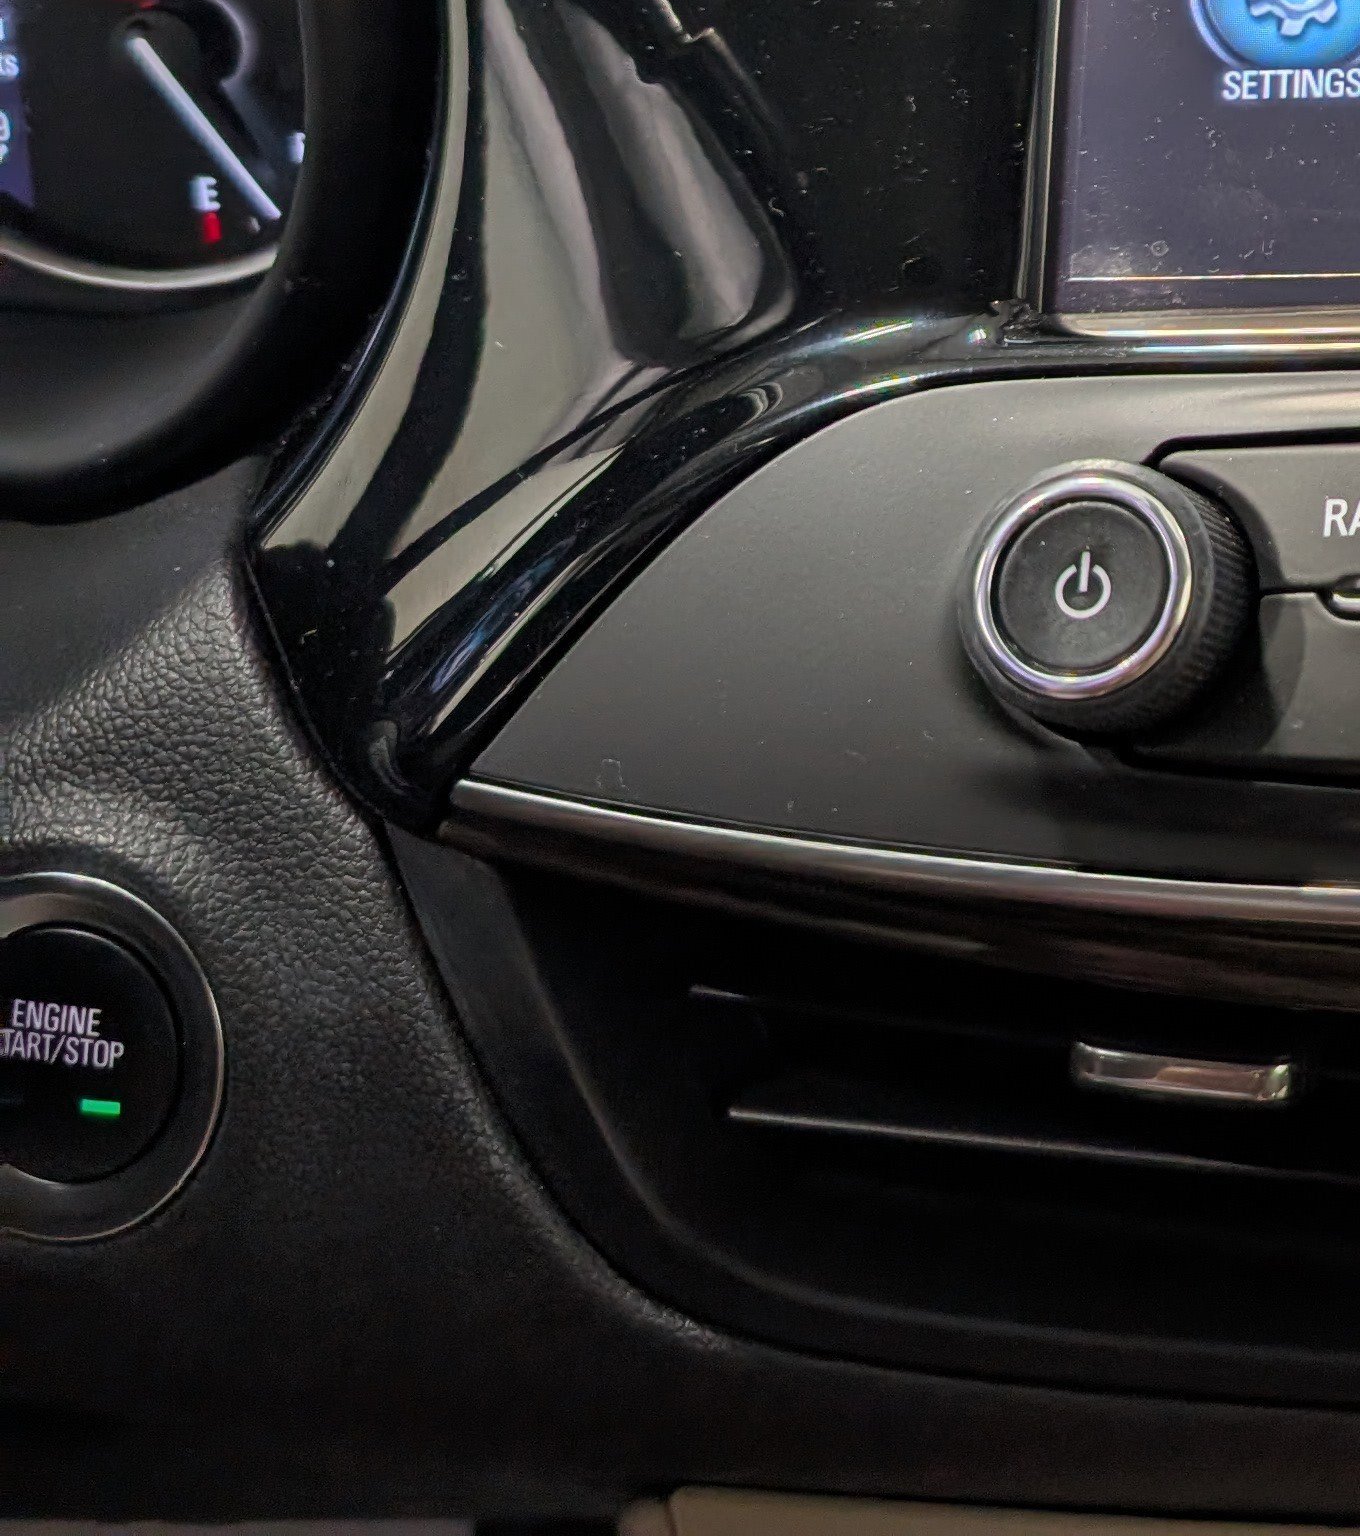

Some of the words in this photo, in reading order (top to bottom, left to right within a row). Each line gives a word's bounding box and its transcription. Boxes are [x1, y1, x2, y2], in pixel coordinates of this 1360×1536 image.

[190, 176, 221, 212] E
[12, 998, 102, 1037] ENGINE
[0, 1027, 125, 1069] TART/STOP
